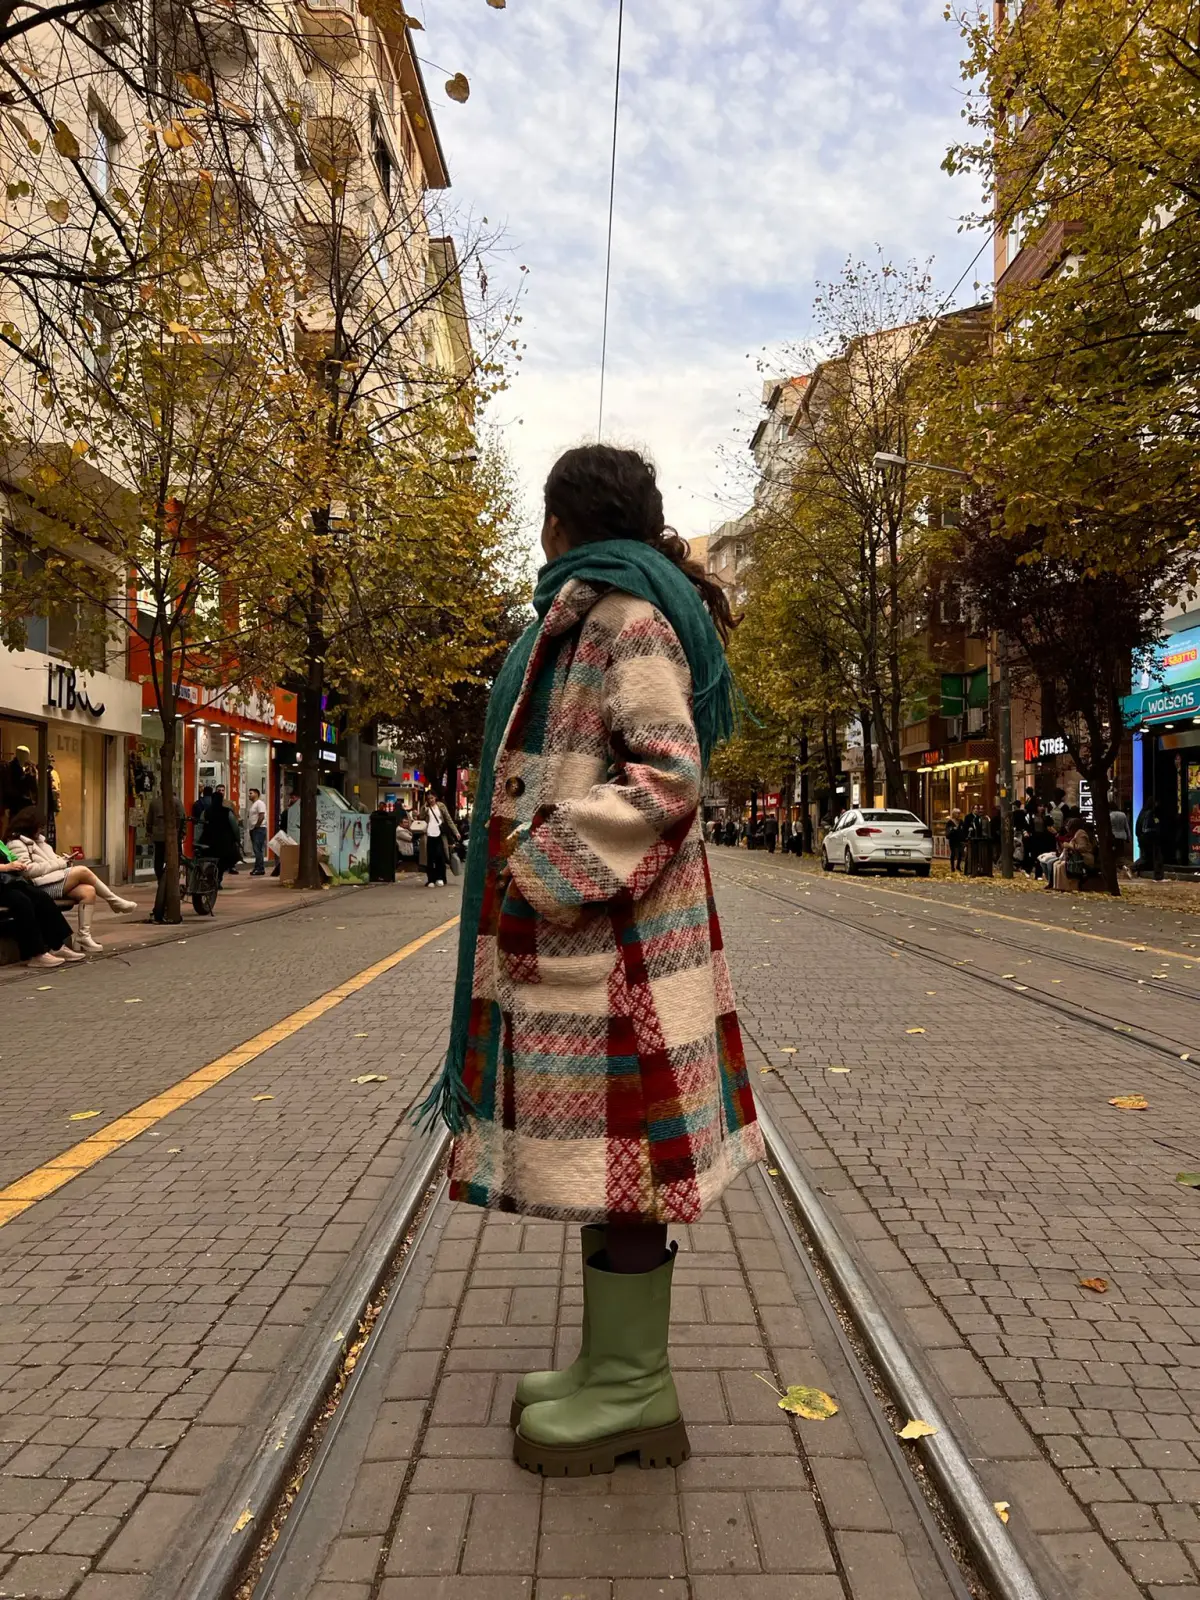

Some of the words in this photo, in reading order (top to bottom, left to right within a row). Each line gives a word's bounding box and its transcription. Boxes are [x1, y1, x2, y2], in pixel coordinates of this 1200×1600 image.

[48, 662, 76, 711] LTB
[1148, 692, 1194, 713] watsons
[1025, 737, 1039, 762] IN
